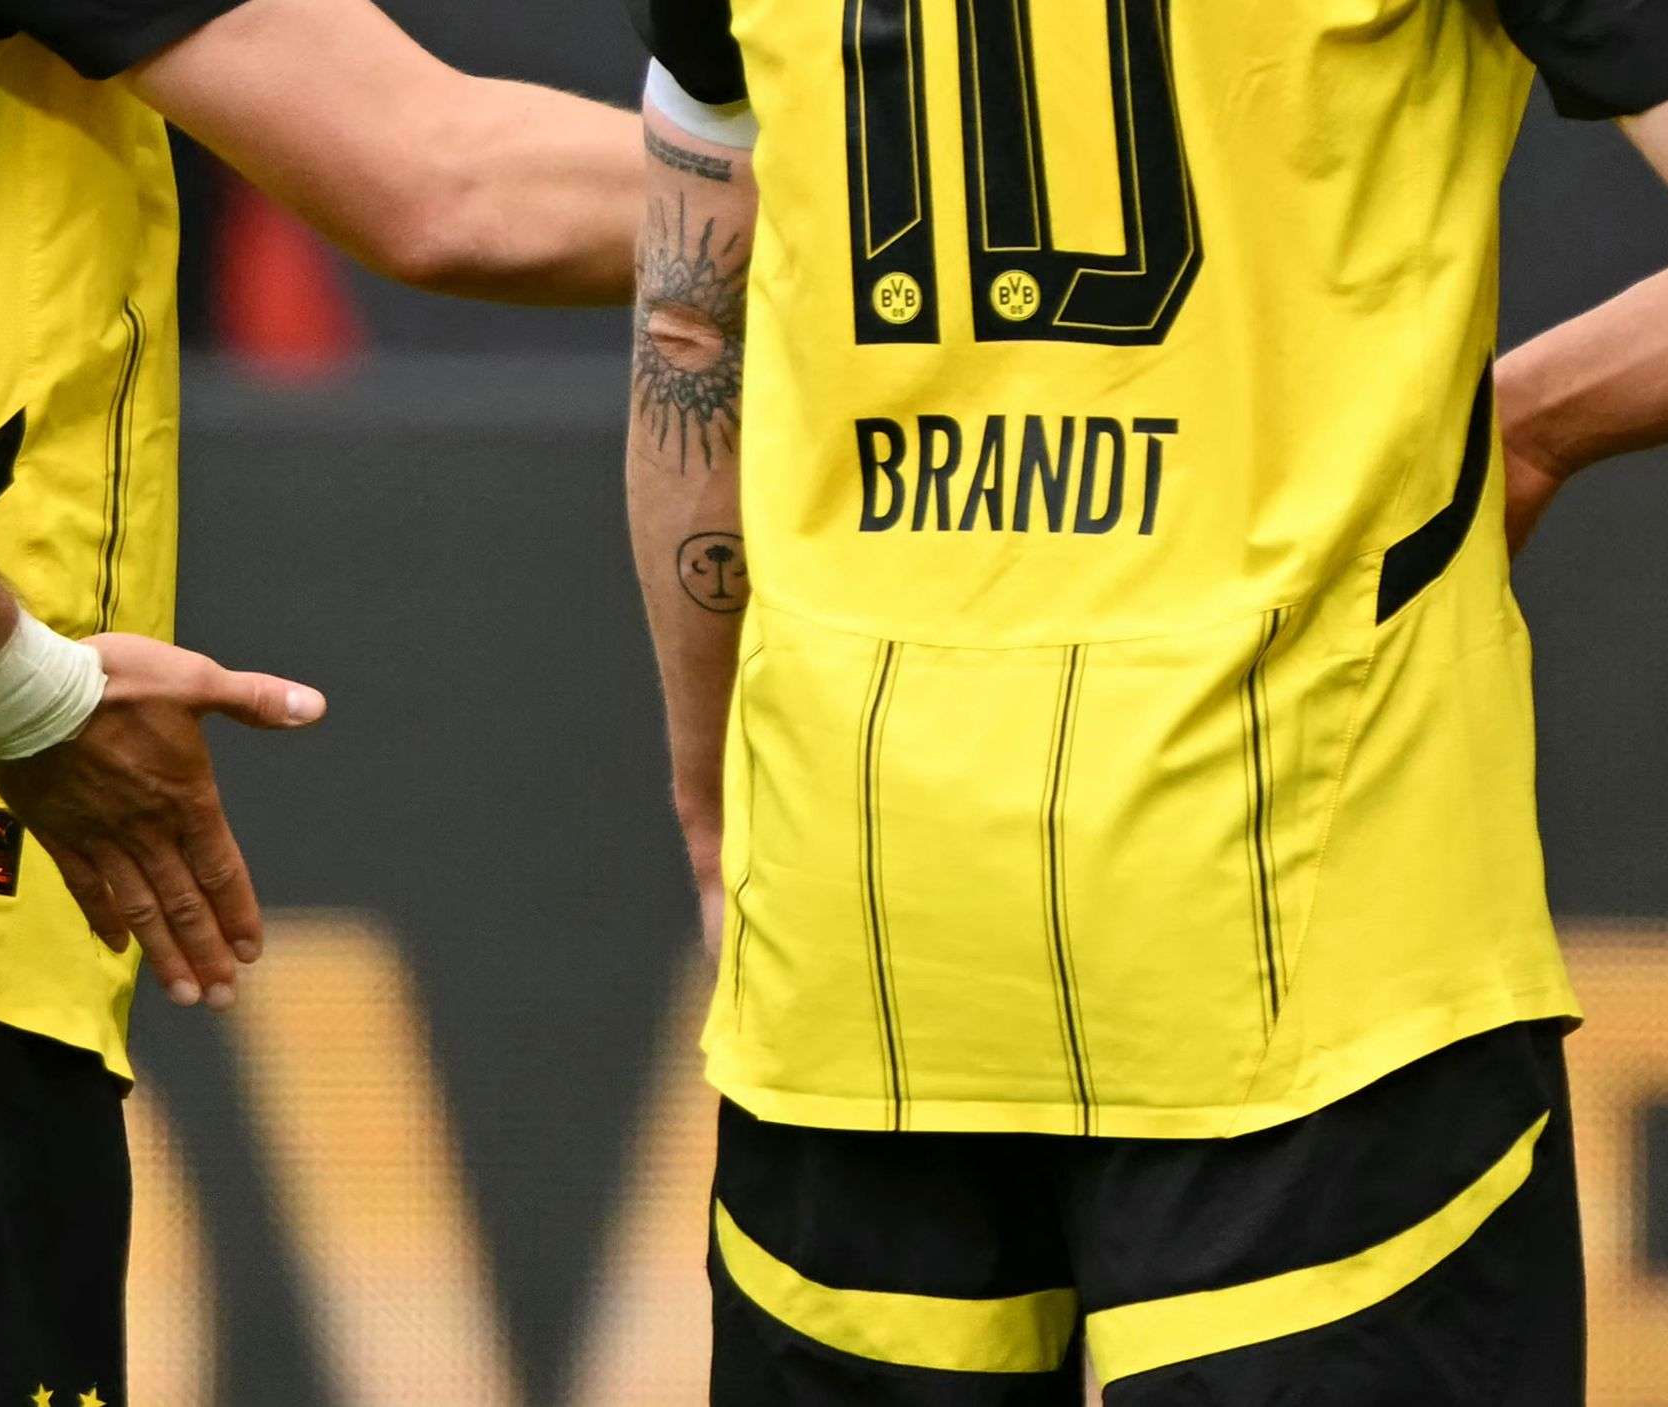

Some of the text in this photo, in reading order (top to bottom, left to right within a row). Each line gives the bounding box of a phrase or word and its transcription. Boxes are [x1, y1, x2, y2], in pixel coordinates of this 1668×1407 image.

[881, 278, 916, 308] BVB
[999, 276, 1034, 306] BVB
[855, 414, 1180, 537] BRANDT
